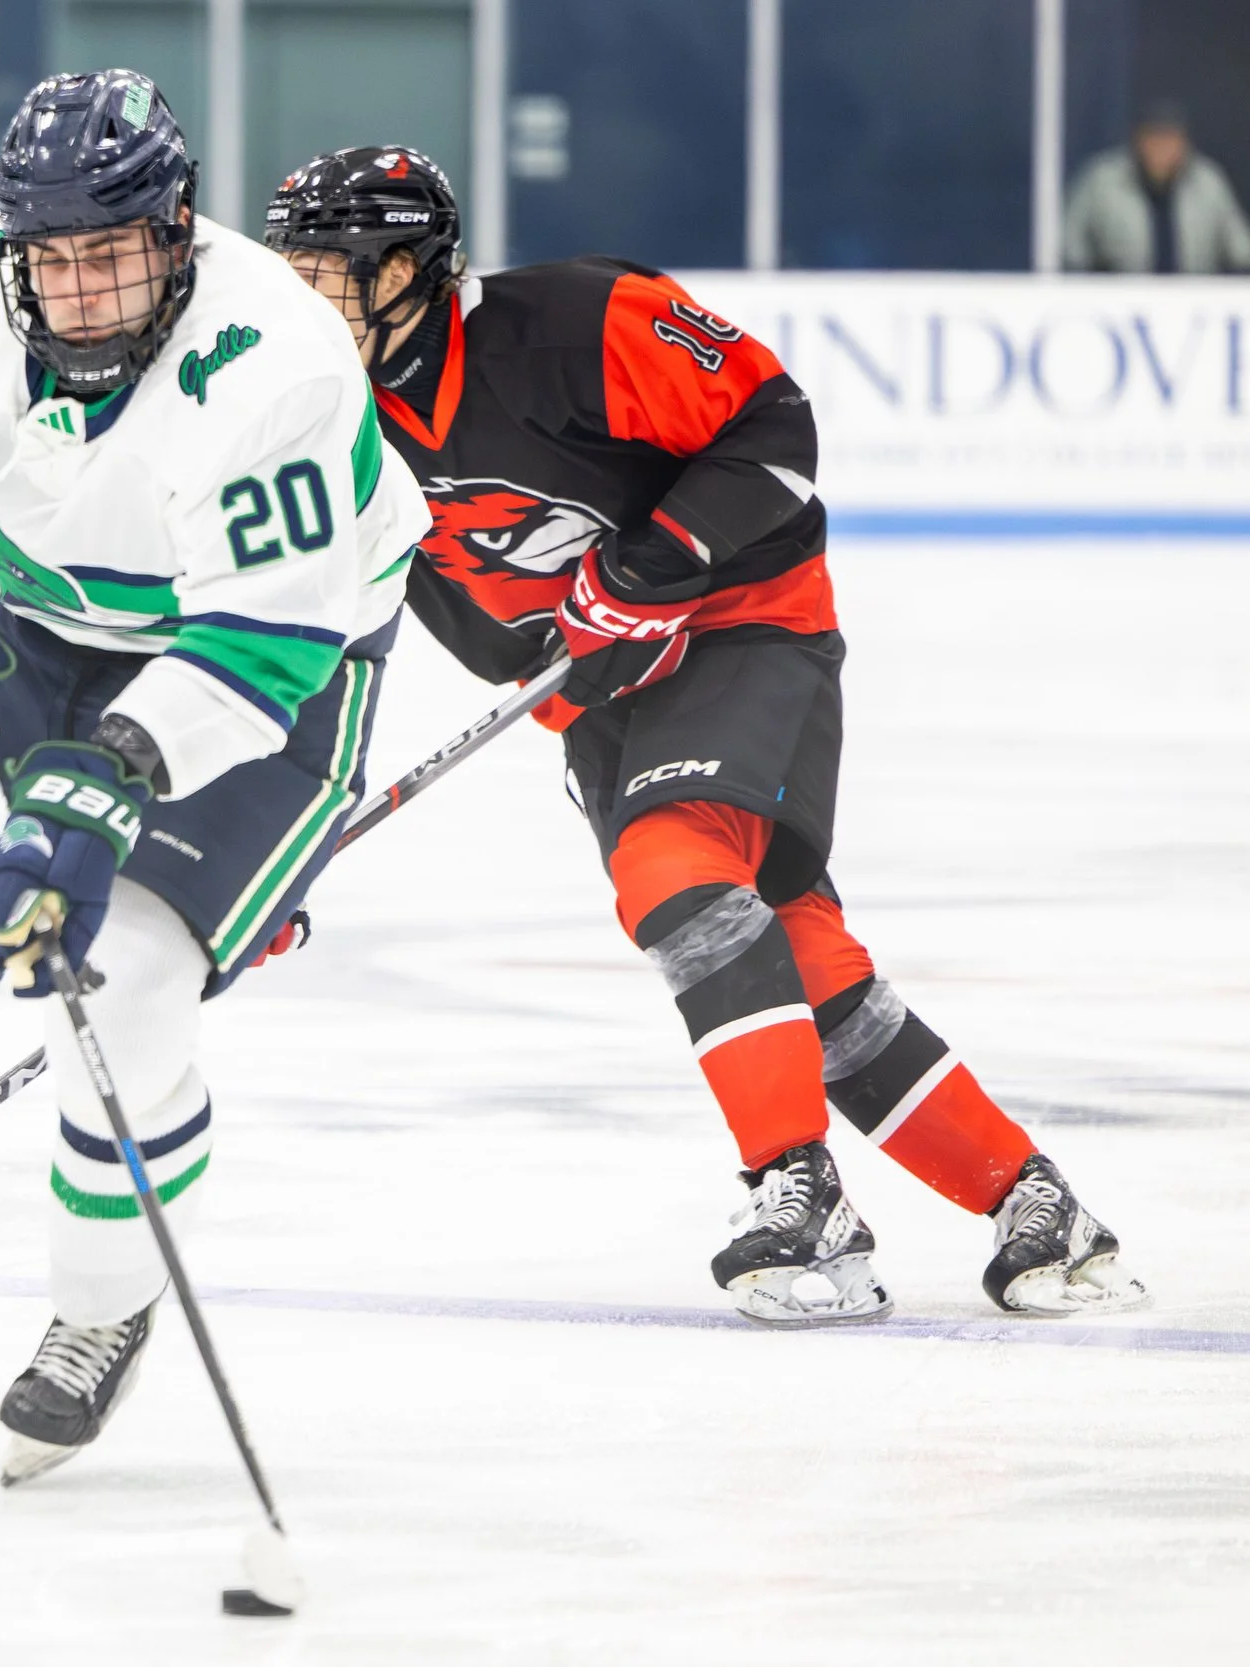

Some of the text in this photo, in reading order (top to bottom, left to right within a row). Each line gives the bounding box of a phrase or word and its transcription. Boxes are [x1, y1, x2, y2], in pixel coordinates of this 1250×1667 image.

[384, 211, 431, 223] CCM
[68, 364, 122, 381] CCM
[178, 323, 262, 405] Gulls
[381, 357, 423, 389] AUER
[219, 458, 334, 571] 20
[575, 569, 691, 638] CCM
[624, 760, 722, 797] CCM
